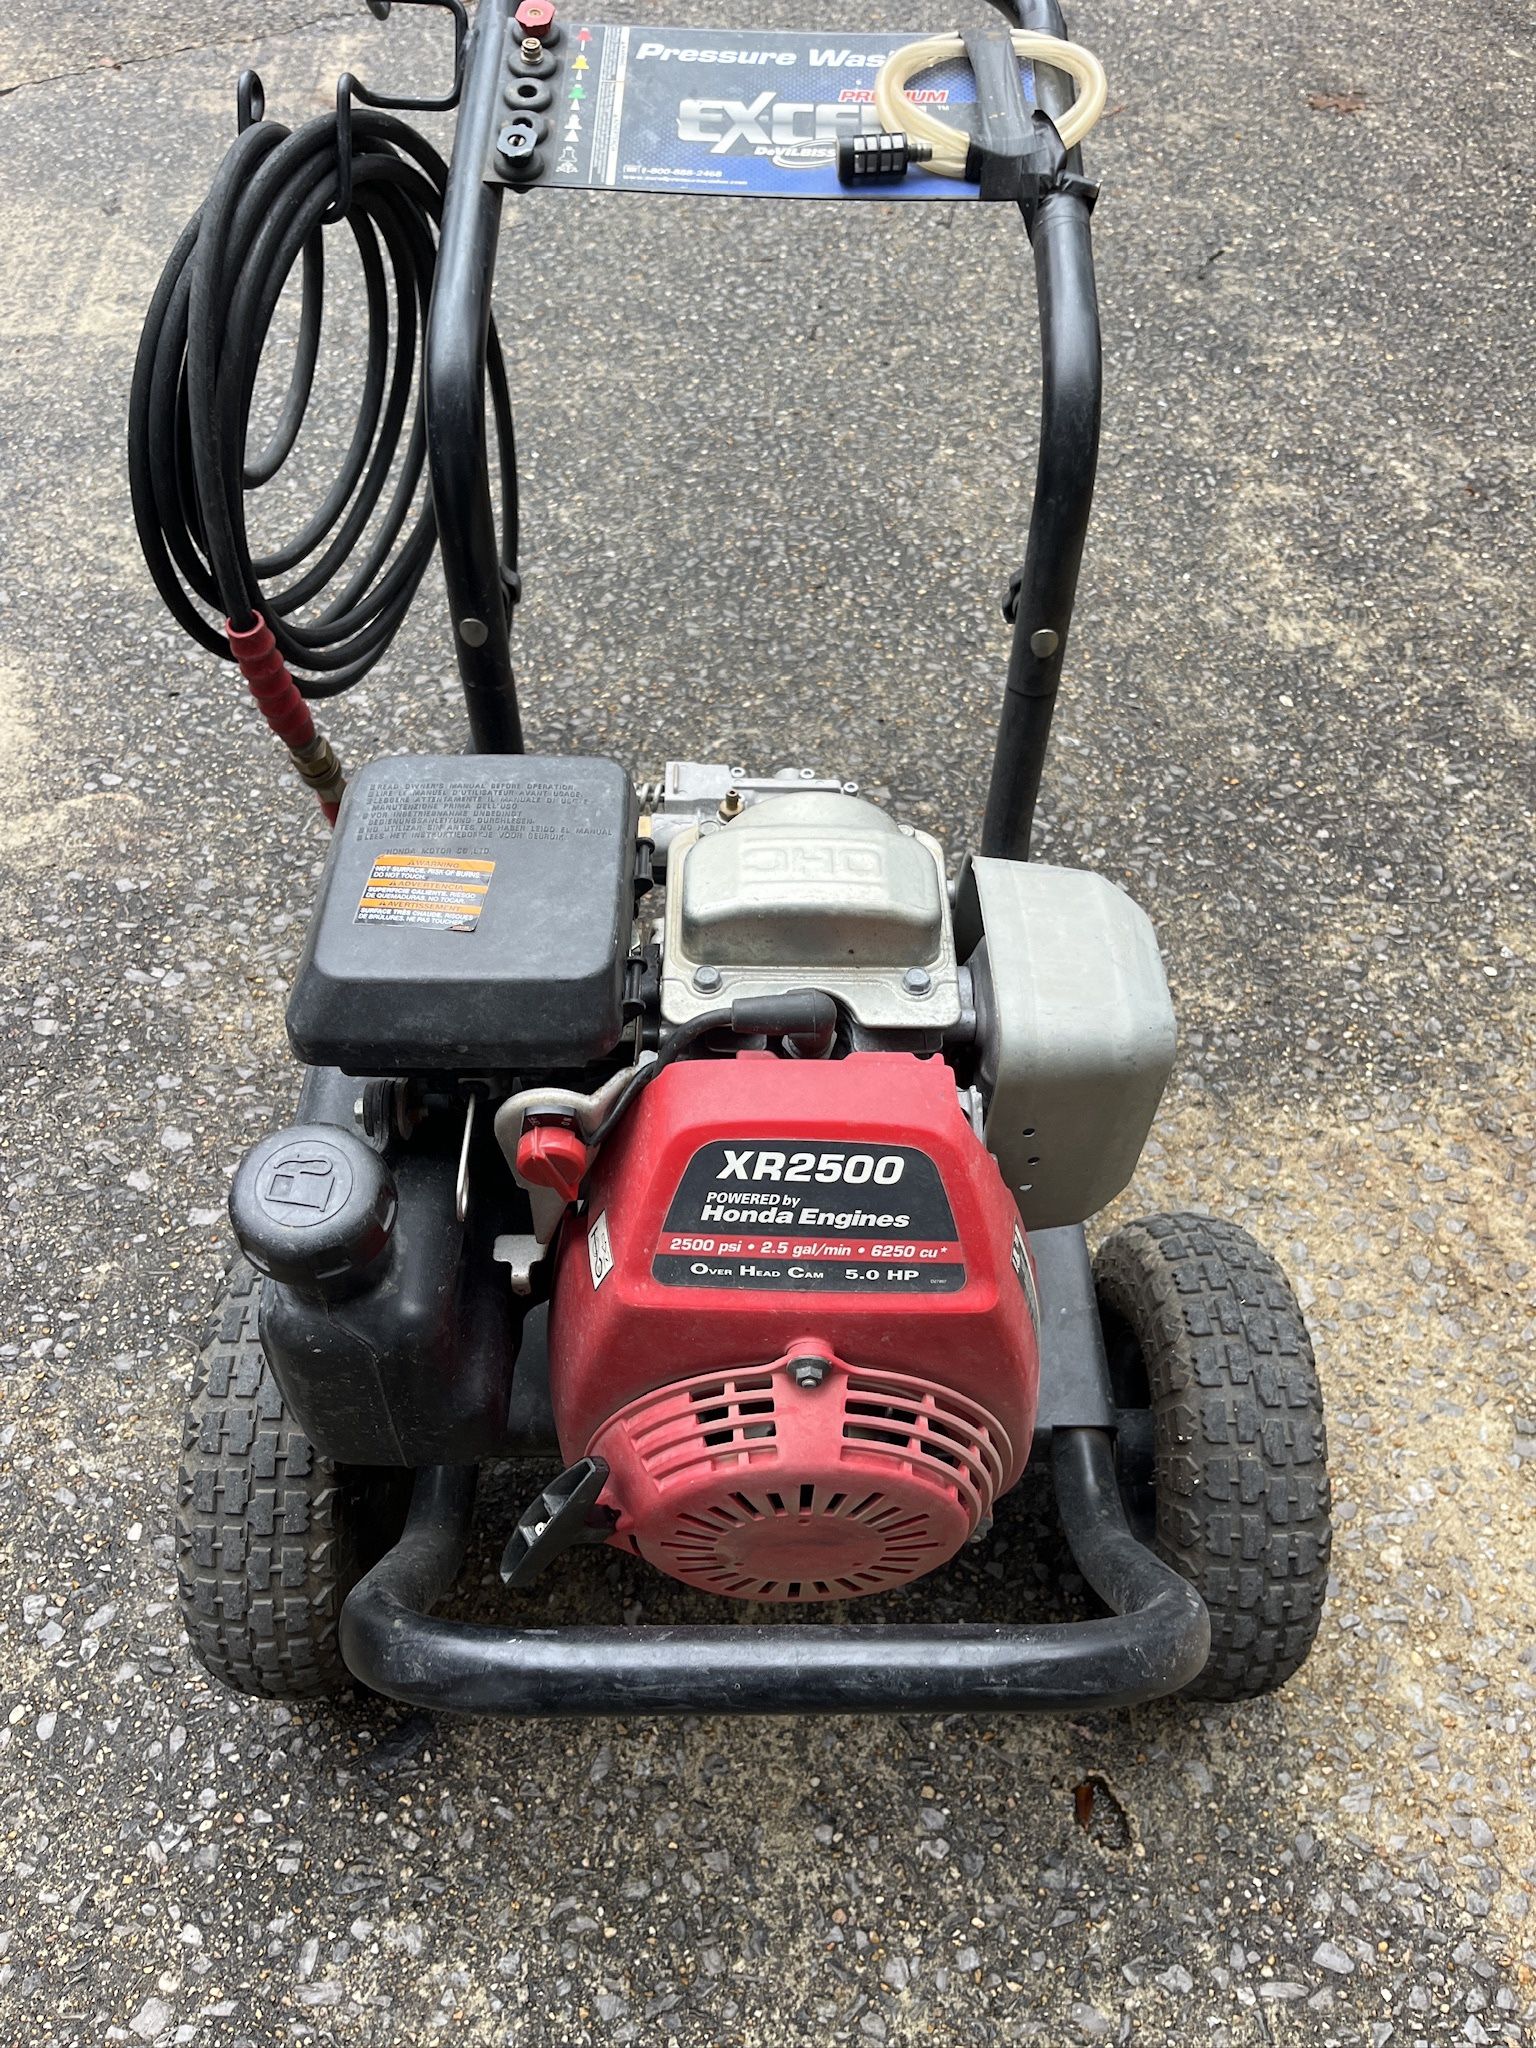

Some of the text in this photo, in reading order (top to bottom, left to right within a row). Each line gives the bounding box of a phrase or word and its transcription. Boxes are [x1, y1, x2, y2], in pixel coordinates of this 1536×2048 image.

[635, 42, 797, 66] Pressure
[371, 803, 438, 811] MANUTENZIONE
[393, 810, 468, 818] INBETRIEBNAHME
[531, 825, 556, 833] LEIDO
[560, 826, 570, 834] EL
[575, 827, 613, 836] MANUAL
[385, 847, 416, 855] HONDA
[421, 847, 452, 855] MOTOR
[413, 860, 460, 868] WARNING
[398, 880, 464, 890] ADVERTENCIA
[367, 886, 410, 894] SUPERFICIE
[449, 891, 477, 899] RIESGO
[388, 901, 461, 912] AVERTISSEMENT
[360, 907, 393, 915] SURFACE
[444, 912, 475, 921] RISQUES
[715, 1150, 905, 1185] XR2500
[705, 1192, 801, 1208] POWERED by
[700, 1204, 911, 1229] Honda Engines
[669, 1238, 715, 1252] 2500
[717, 1239, 742, 1256] psi
[760, 1241, 788, 1255] 2.5
[791, 1242, 852, 1258] gal/min
[870, 1244, 915, 1258] 6250
[844, 1268, 880, 1281] 5.0
[886, 1269, 920, 1281] HP
